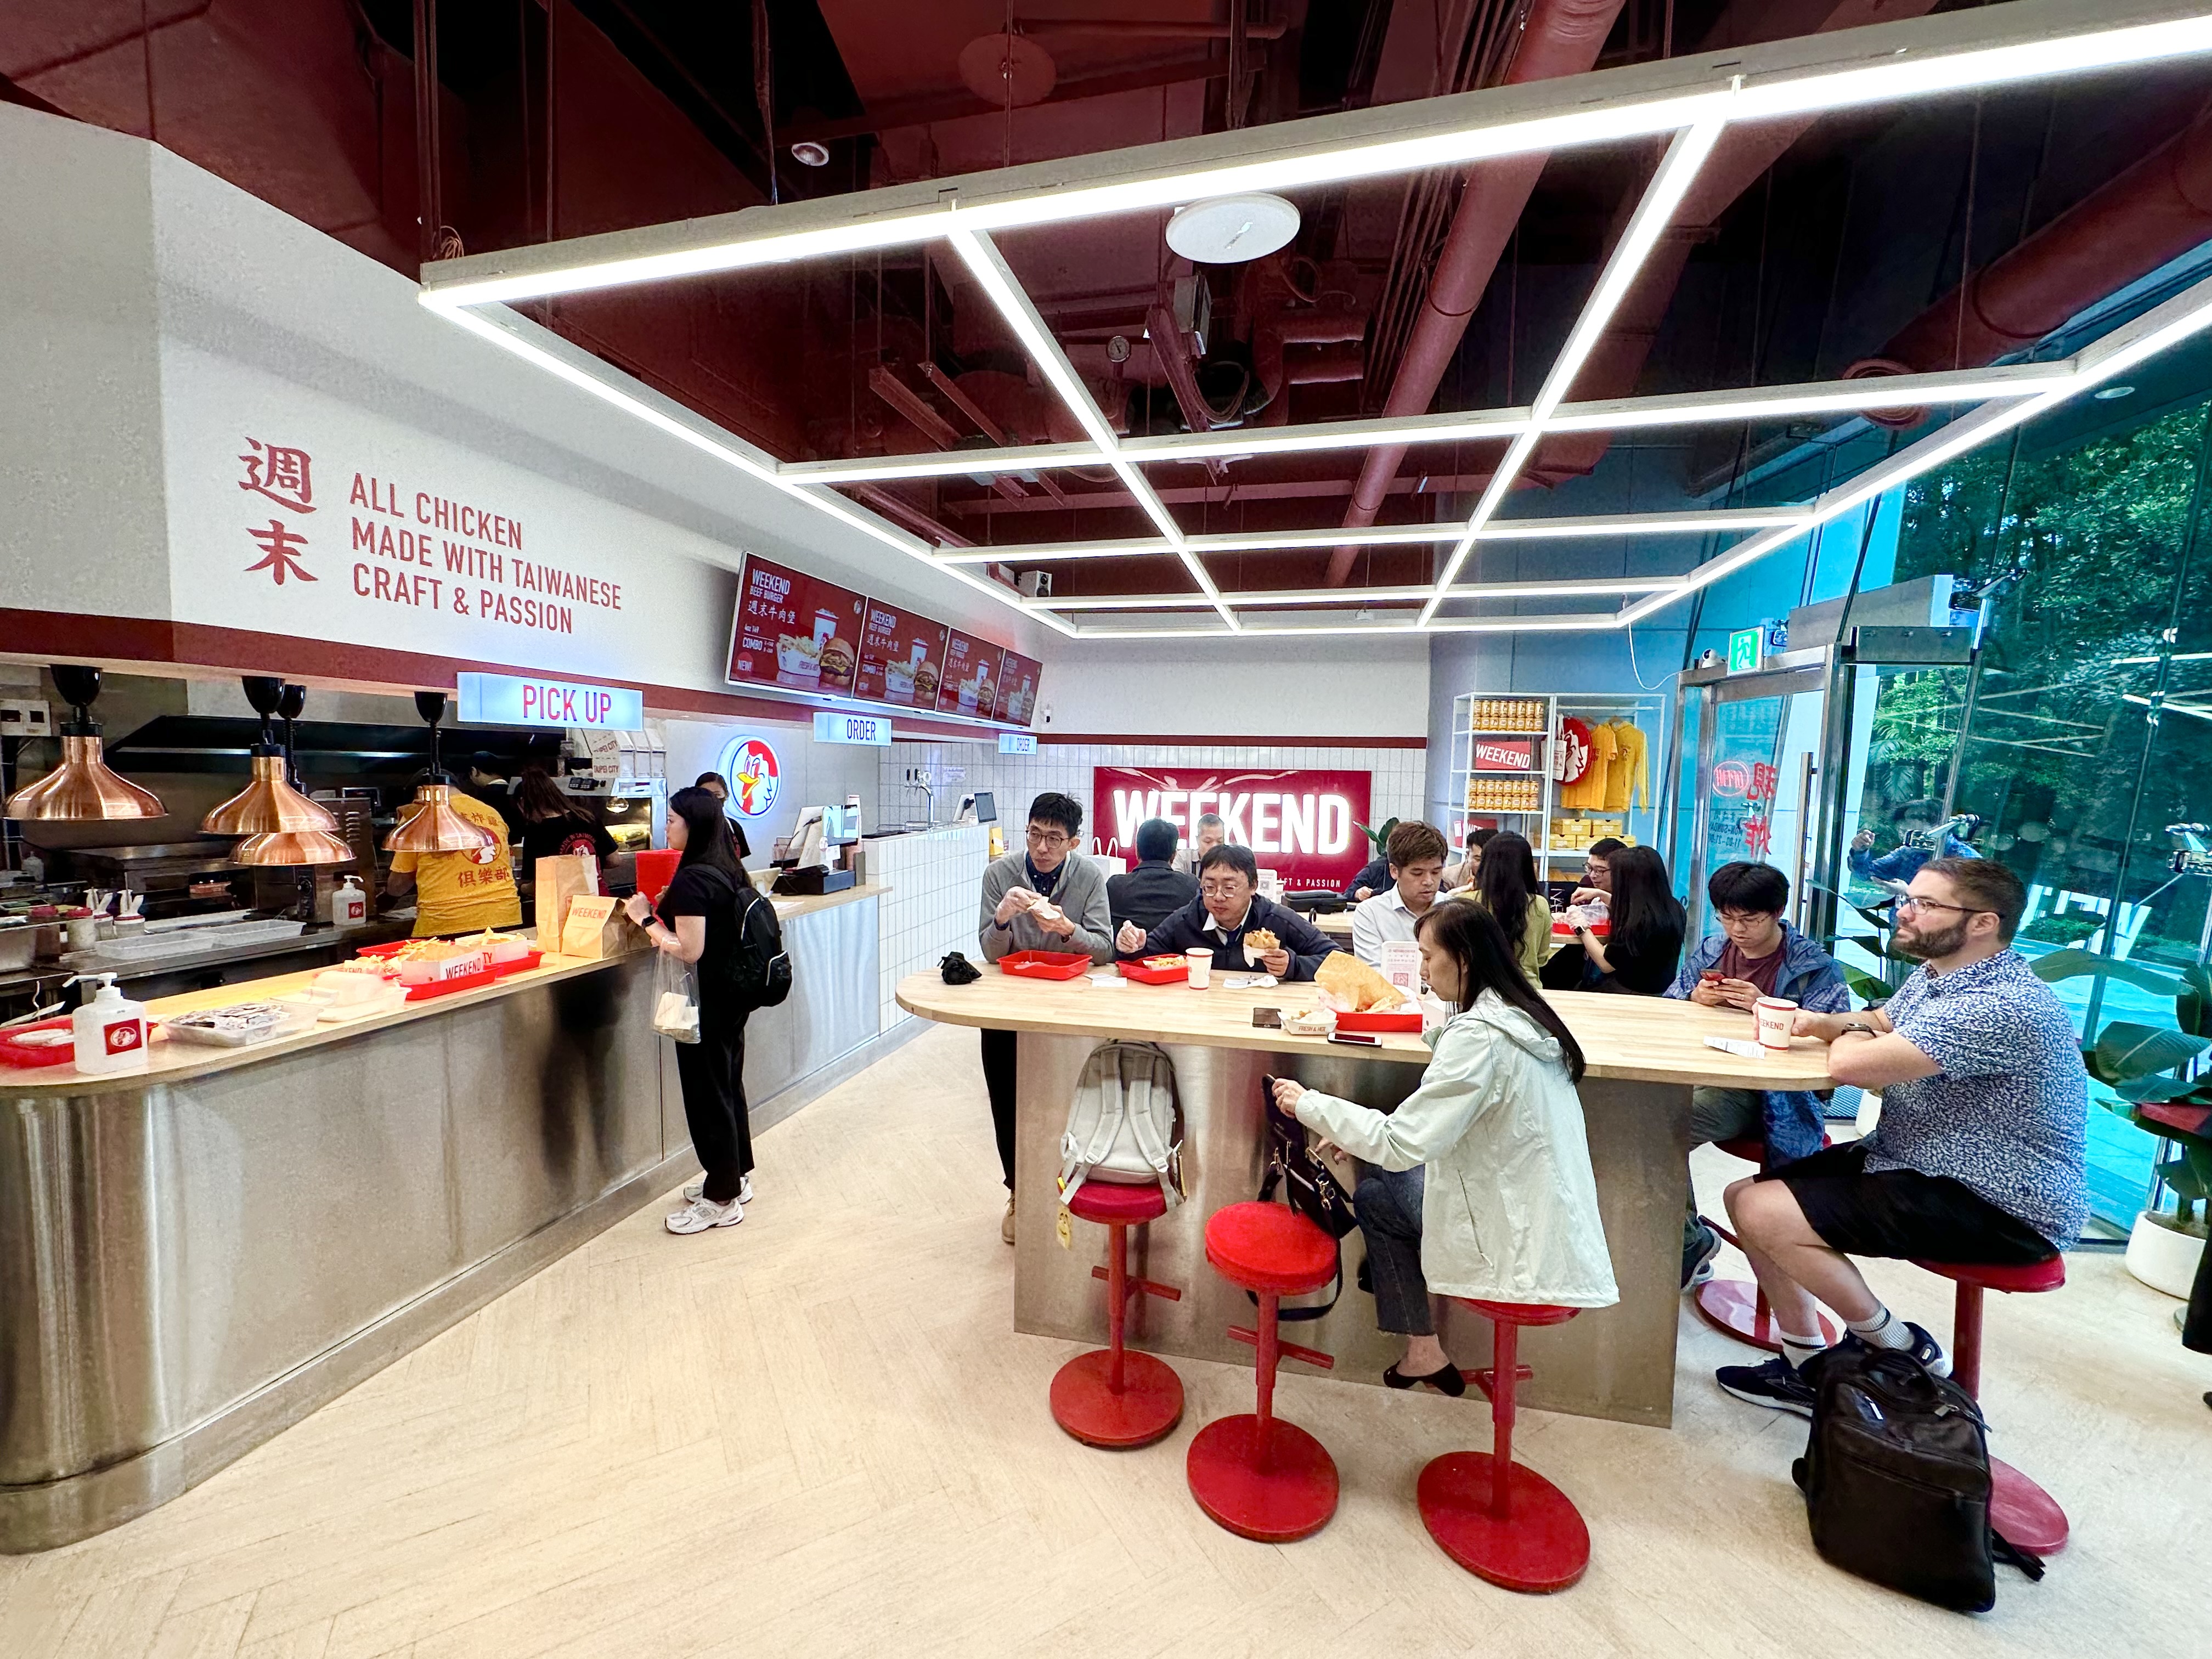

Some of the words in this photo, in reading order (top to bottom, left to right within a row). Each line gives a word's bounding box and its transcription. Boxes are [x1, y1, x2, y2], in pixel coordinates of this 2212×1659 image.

[239, 436, 318, 586] 週末
[349, 472, 405, 519] ALL
[416, 492, 523, 551] CHICKEN
[352, 516, 432, 567] MADE
[442, 539, 504, 583] WITH
[512, 557, 622, 611] TAIWANESE
[752, 568, 790, 595] WEEKEND
[353, 562, 442, 610] CRAFT
[453, 586, 472, 615] &
[479, 589, 573, 634] PASSION
[749, 585, 763, 598] BEEF
[763, 589, 784, 604] BURGER
[747, 600, 796, 625] 週末牛肉堡
[871, 608, 896, 629] WEEKEND
[742, 636, 763, 651] COMBO
[522, 685, 577, 722] PICK
[585, 692, 612, 724] UP
[847, 719, 876, 742] ORDER
[607, 740, 618, 751] CITY
[1017, 737, 1030, 752] ORDER
[1476, 743, 1531, 769] WEEKEND
[594, 765, 607, 773] TAIPEI
[608, 765, 619, 773] CITY
[1113, 789, 1351, 855] WEEKEND
[559, 837, 571, 854] MADE
[458, 866, 510, 888] 俱樂部
[1297, 878, 1302, 887] &
[1306, 879, 1341, 888] PASSION
[572, 907, 607, 919] WEEKEND
[445, 957, 482, 980] WEEKEND
[483, 952, 493, 964] TY
[1760, 1019, 1784, 1030] EEKEND
